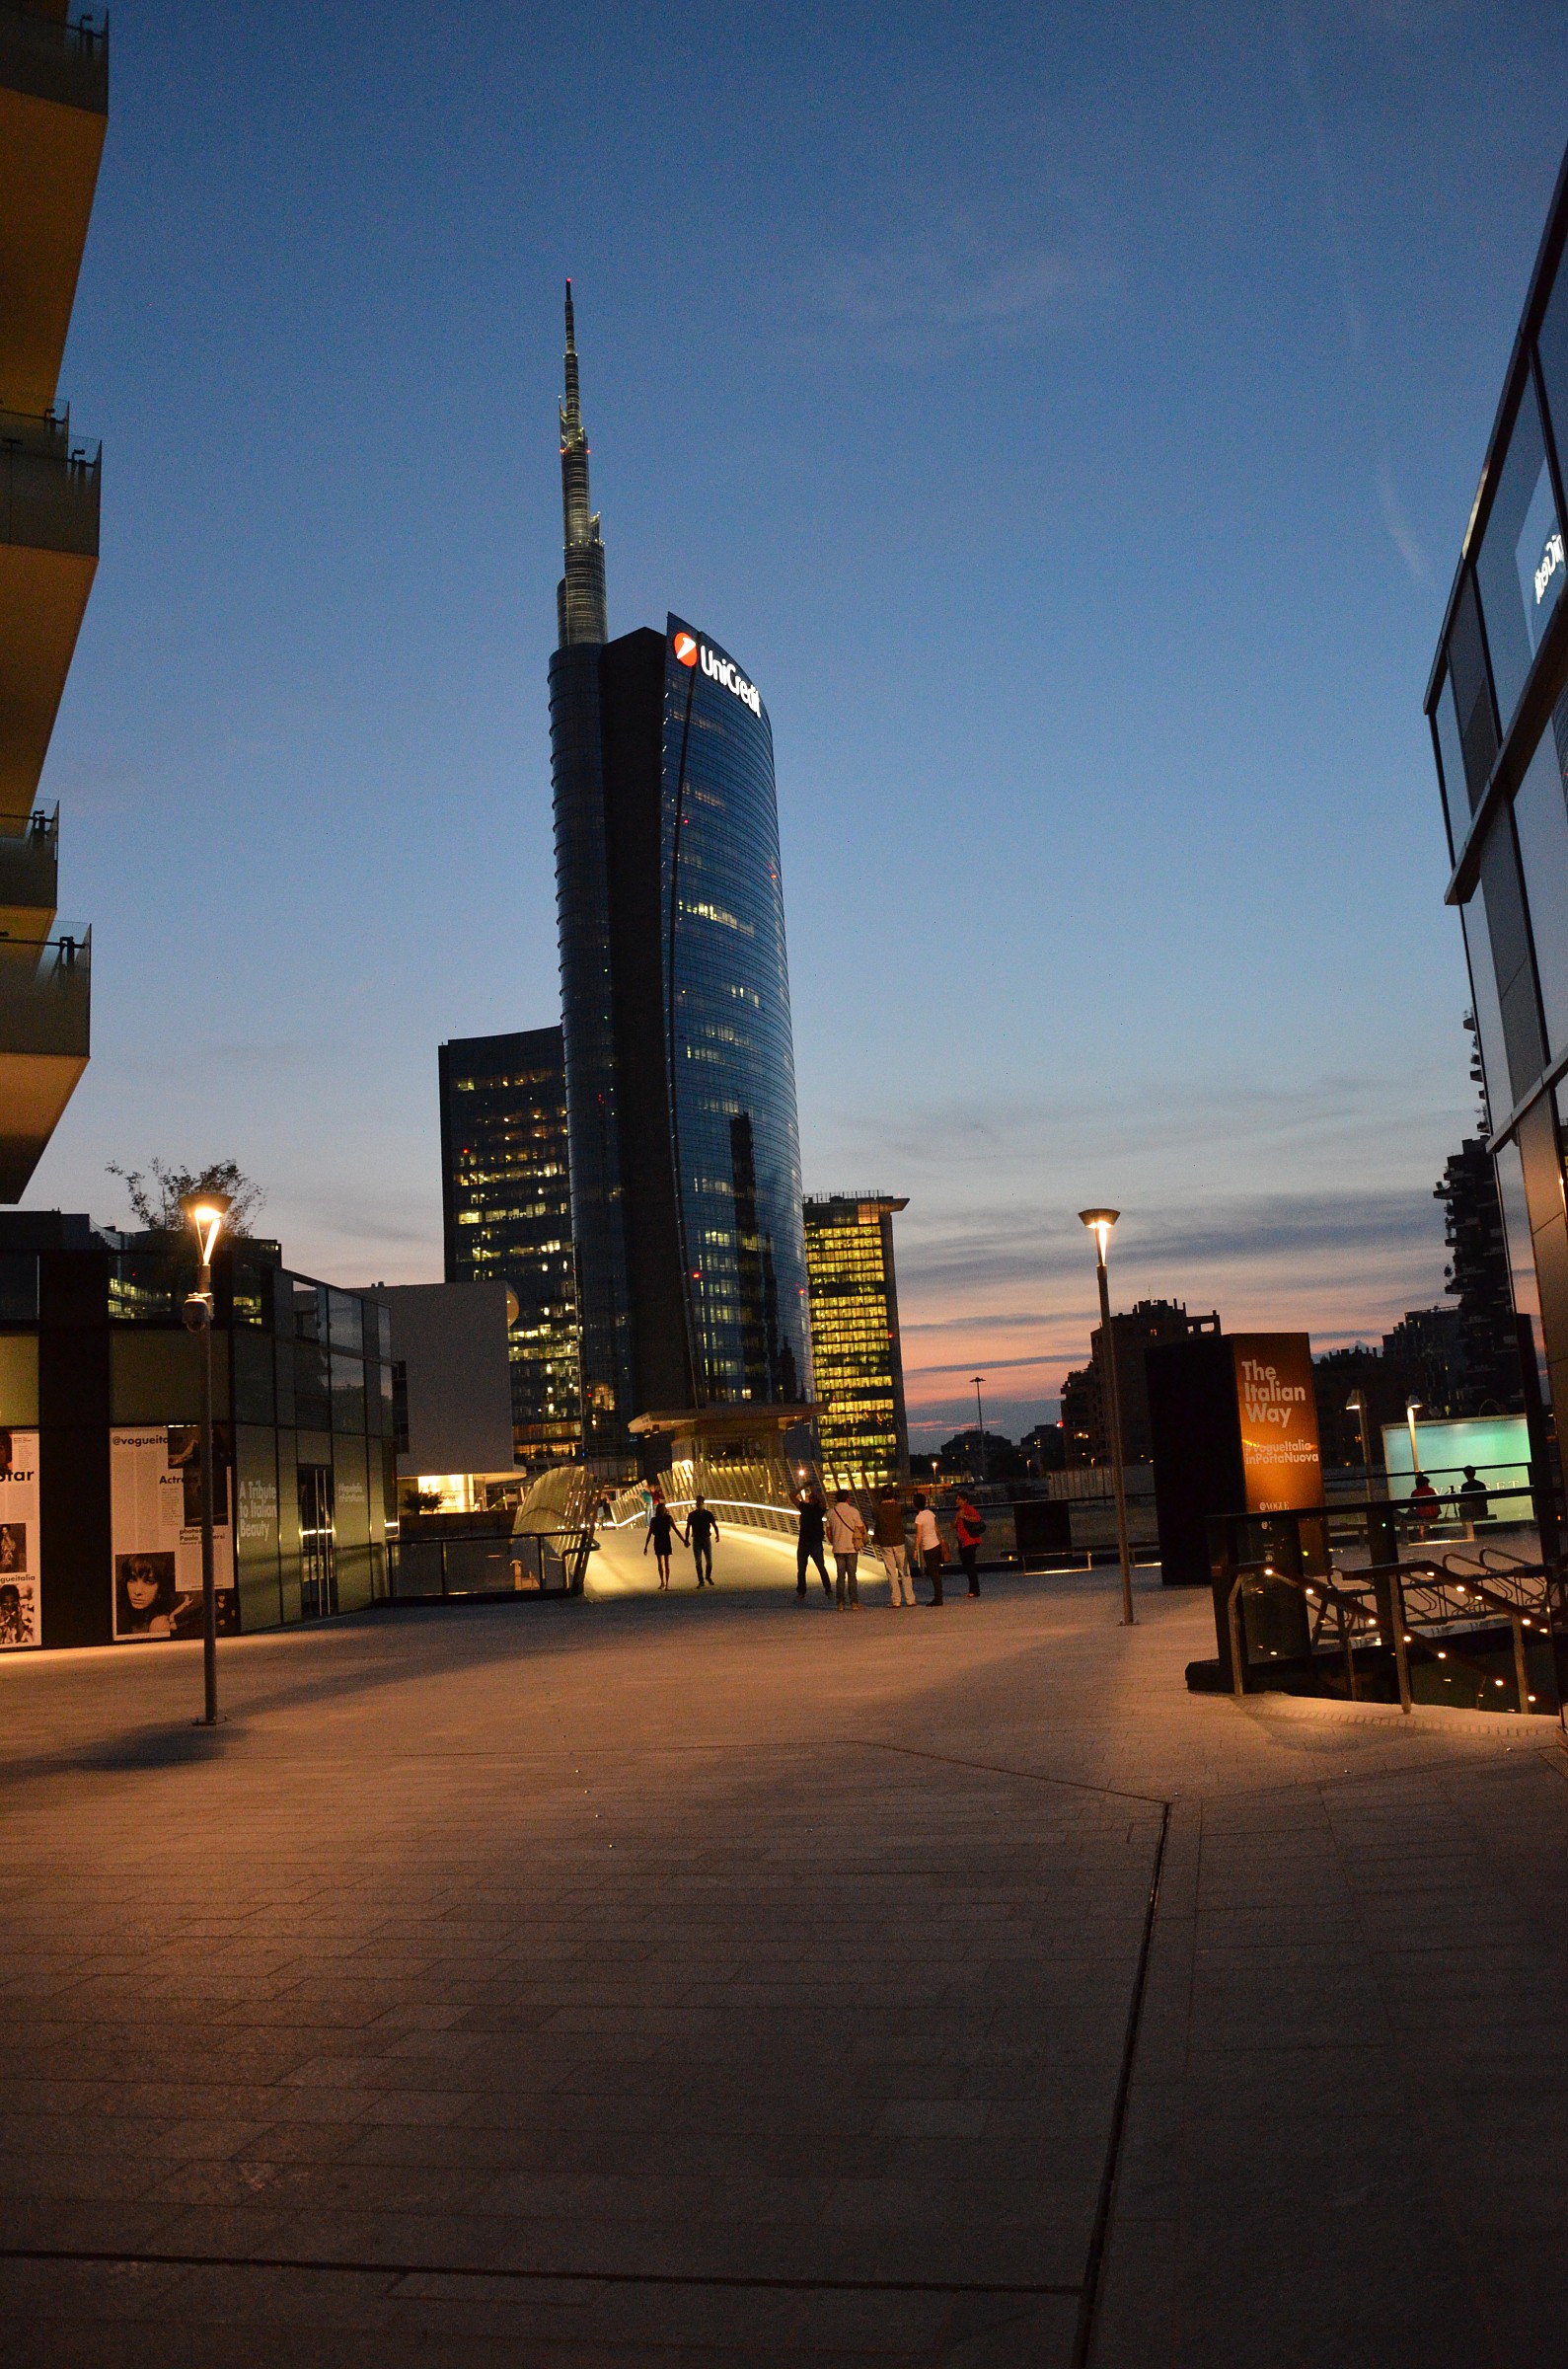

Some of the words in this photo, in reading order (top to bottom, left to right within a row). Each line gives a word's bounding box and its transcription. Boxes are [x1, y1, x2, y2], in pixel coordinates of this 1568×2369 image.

[701, 646, 762, 719] UniCredit
[1241, 1359, 1277, 1381] The
[1244, 1379, 1306, 1402] Italian
[1245, 1403, 1292, 1428] Way
[1245, 1451, 1319, 1465] inPortaNuova
[239, 1481, 247, 1499] A
[248, 1481, 277, 1499] Tribute
[239, 1501, 249, 1518] to
[251, 1499, 277, 1518] Italian
[240, 1518, 269, 1542] Beauty
